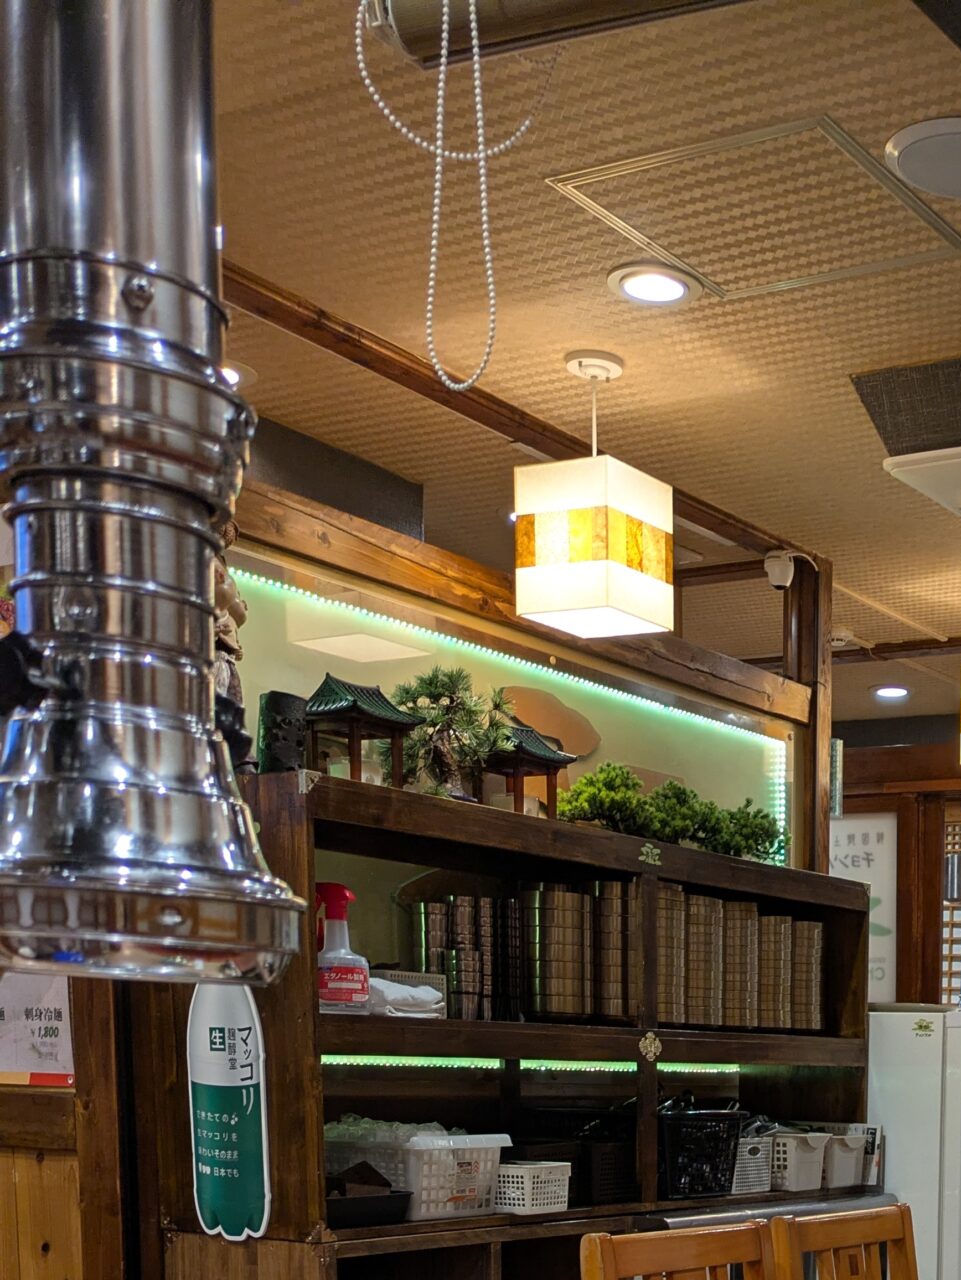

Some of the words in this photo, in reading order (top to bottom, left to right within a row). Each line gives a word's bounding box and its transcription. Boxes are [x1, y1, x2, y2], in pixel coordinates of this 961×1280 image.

[24, 1007, 63, 1022] 刺身冷麺
[31, 1026, 59, 1039] ¥1,800
[211, 1028, 225, 1049] 生
[237, 1026, 254, 1116] マッコリ
[214, 1166, 239, 1178] 日本でも
